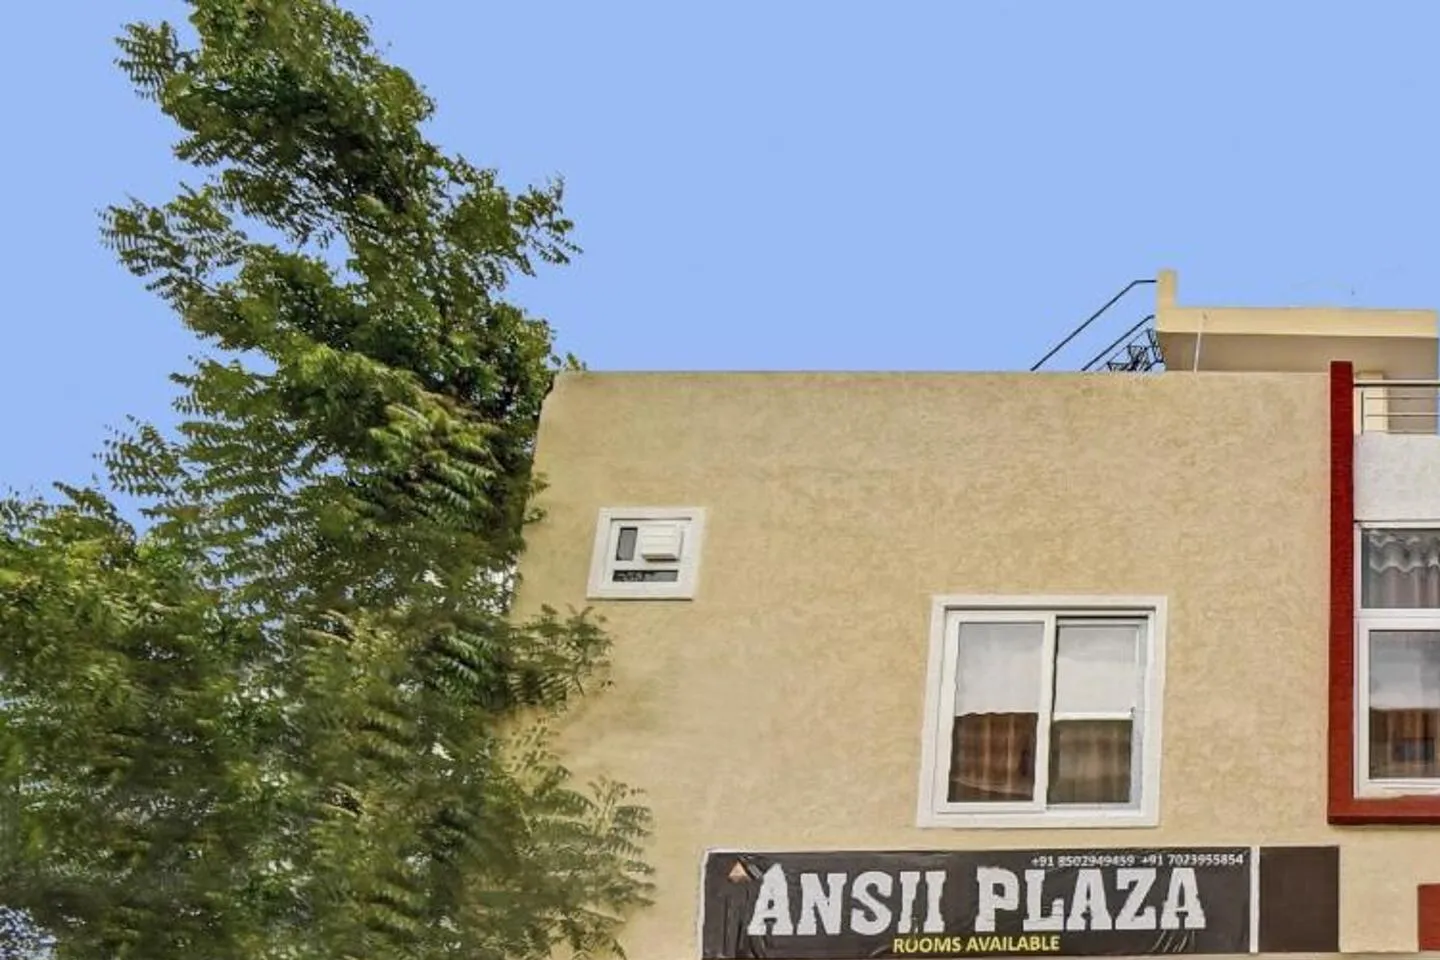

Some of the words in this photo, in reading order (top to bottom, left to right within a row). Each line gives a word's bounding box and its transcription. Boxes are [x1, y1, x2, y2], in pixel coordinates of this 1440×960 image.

[974, 865, 1207, 933] PLAZA
[893, 937, 961, 953] ROOMS
[966, 935, 1061, 952] AVAILABLE
